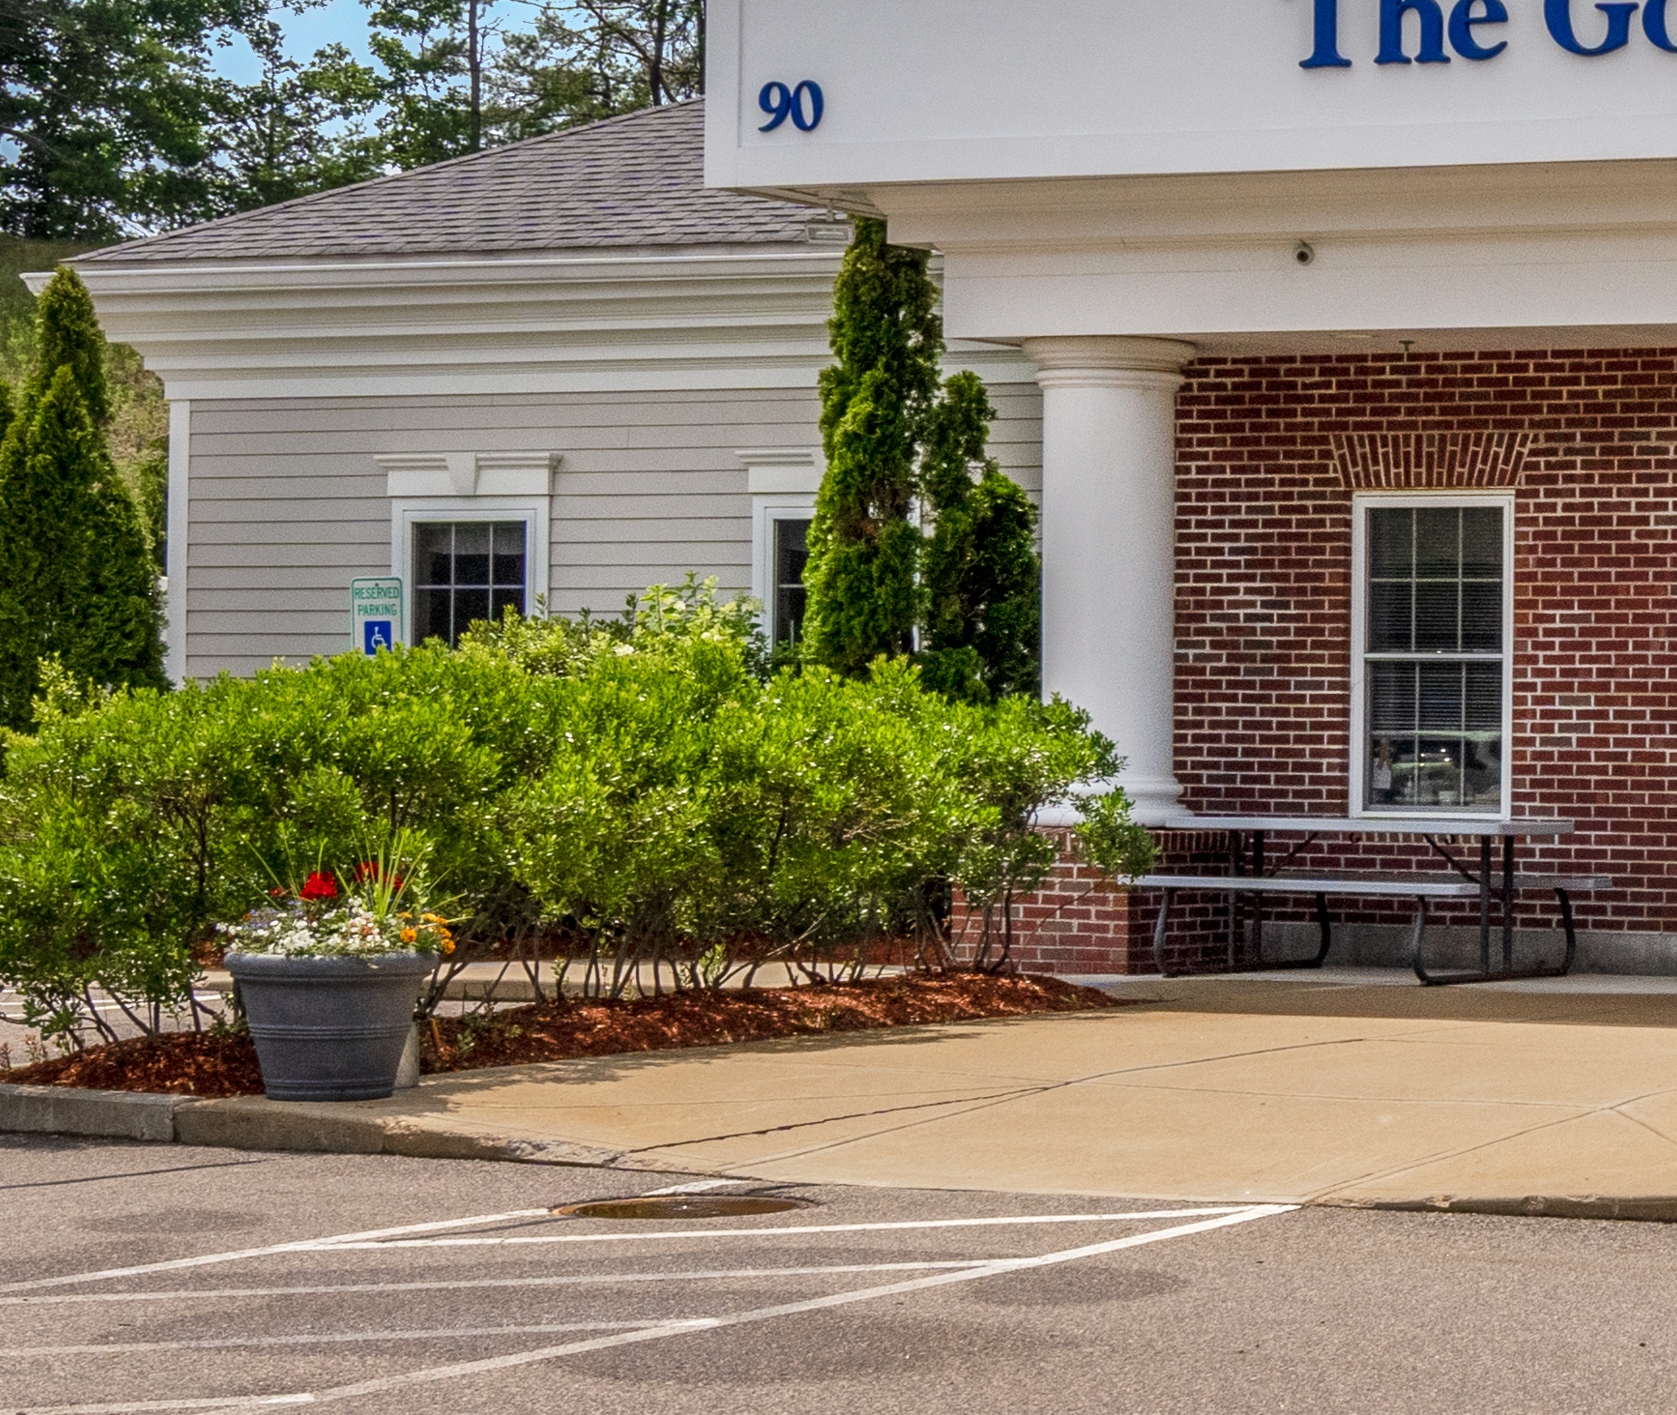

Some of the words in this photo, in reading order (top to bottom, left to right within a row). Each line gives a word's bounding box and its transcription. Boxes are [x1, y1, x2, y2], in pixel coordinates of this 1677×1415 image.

[757, 78, 825, 134] 90
[354, 586, 400, 599] RESERVED
[357, 603, 398, 616] PARKING
